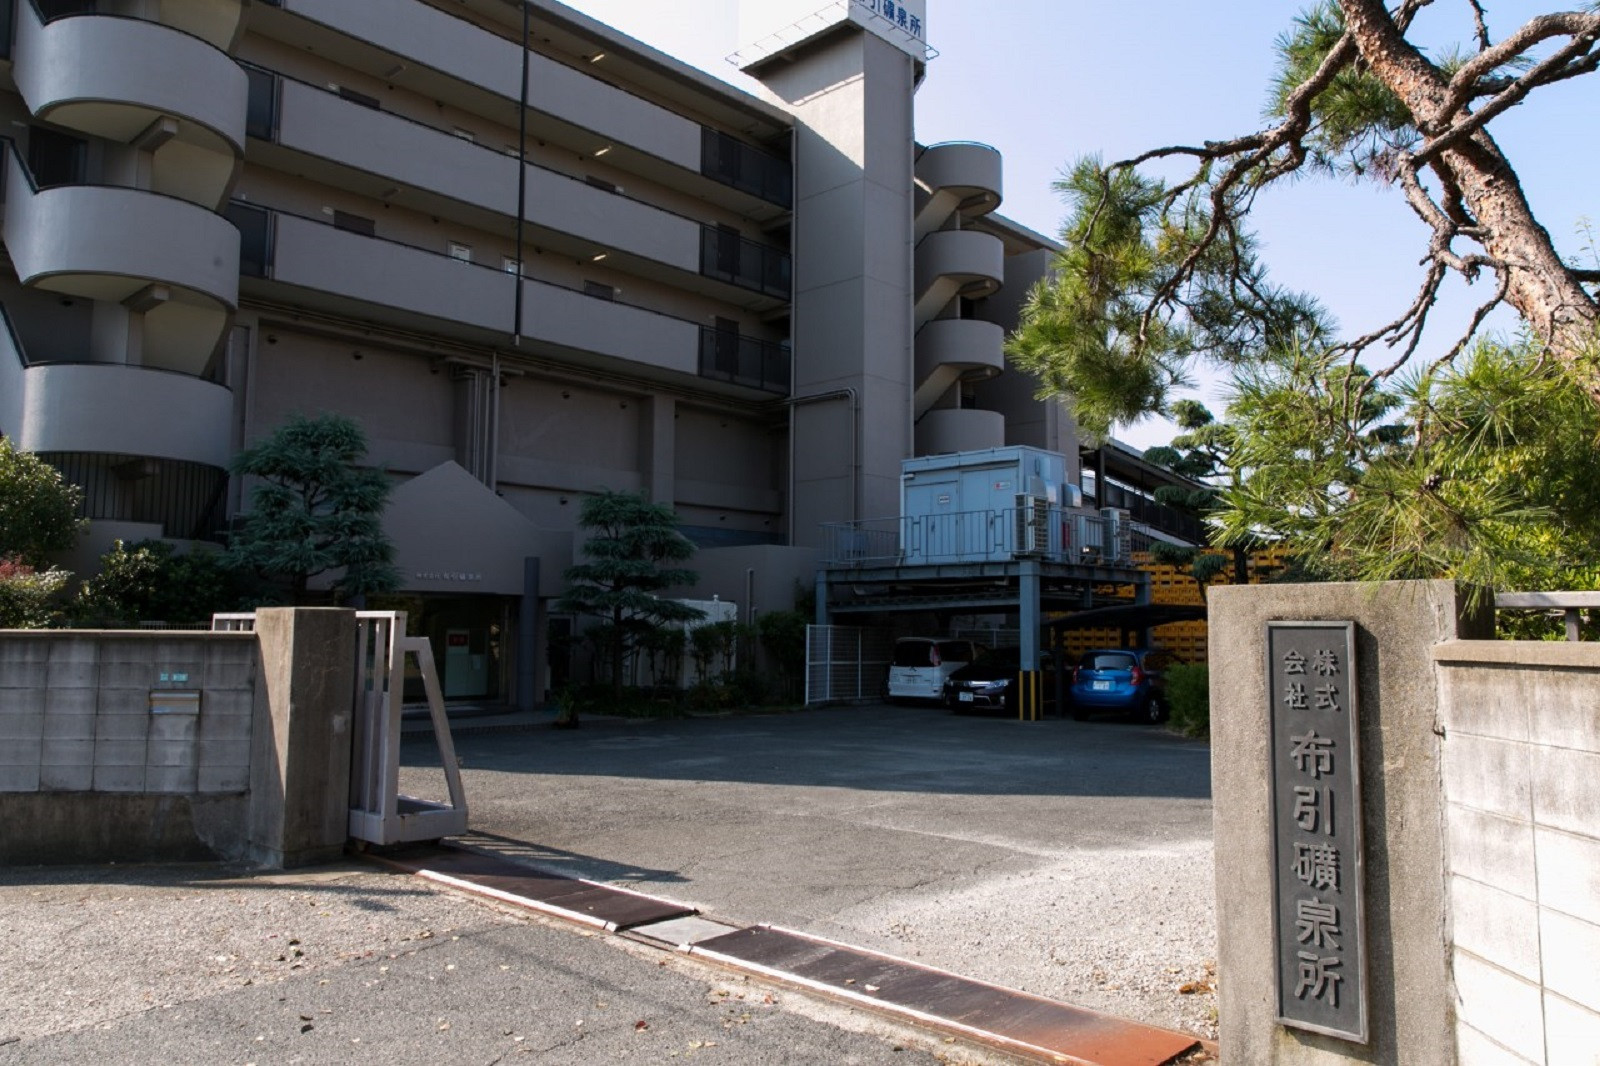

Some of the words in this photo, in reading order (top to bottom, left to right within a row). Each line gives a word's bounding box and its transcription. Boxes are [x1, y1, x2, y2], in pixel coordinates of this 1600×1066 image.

[1283, 649, 1307, 708] 会社
[1312, 649, 1339, 709] 株式
[1290, 729, 1340, 1006] 布引礦泉所
